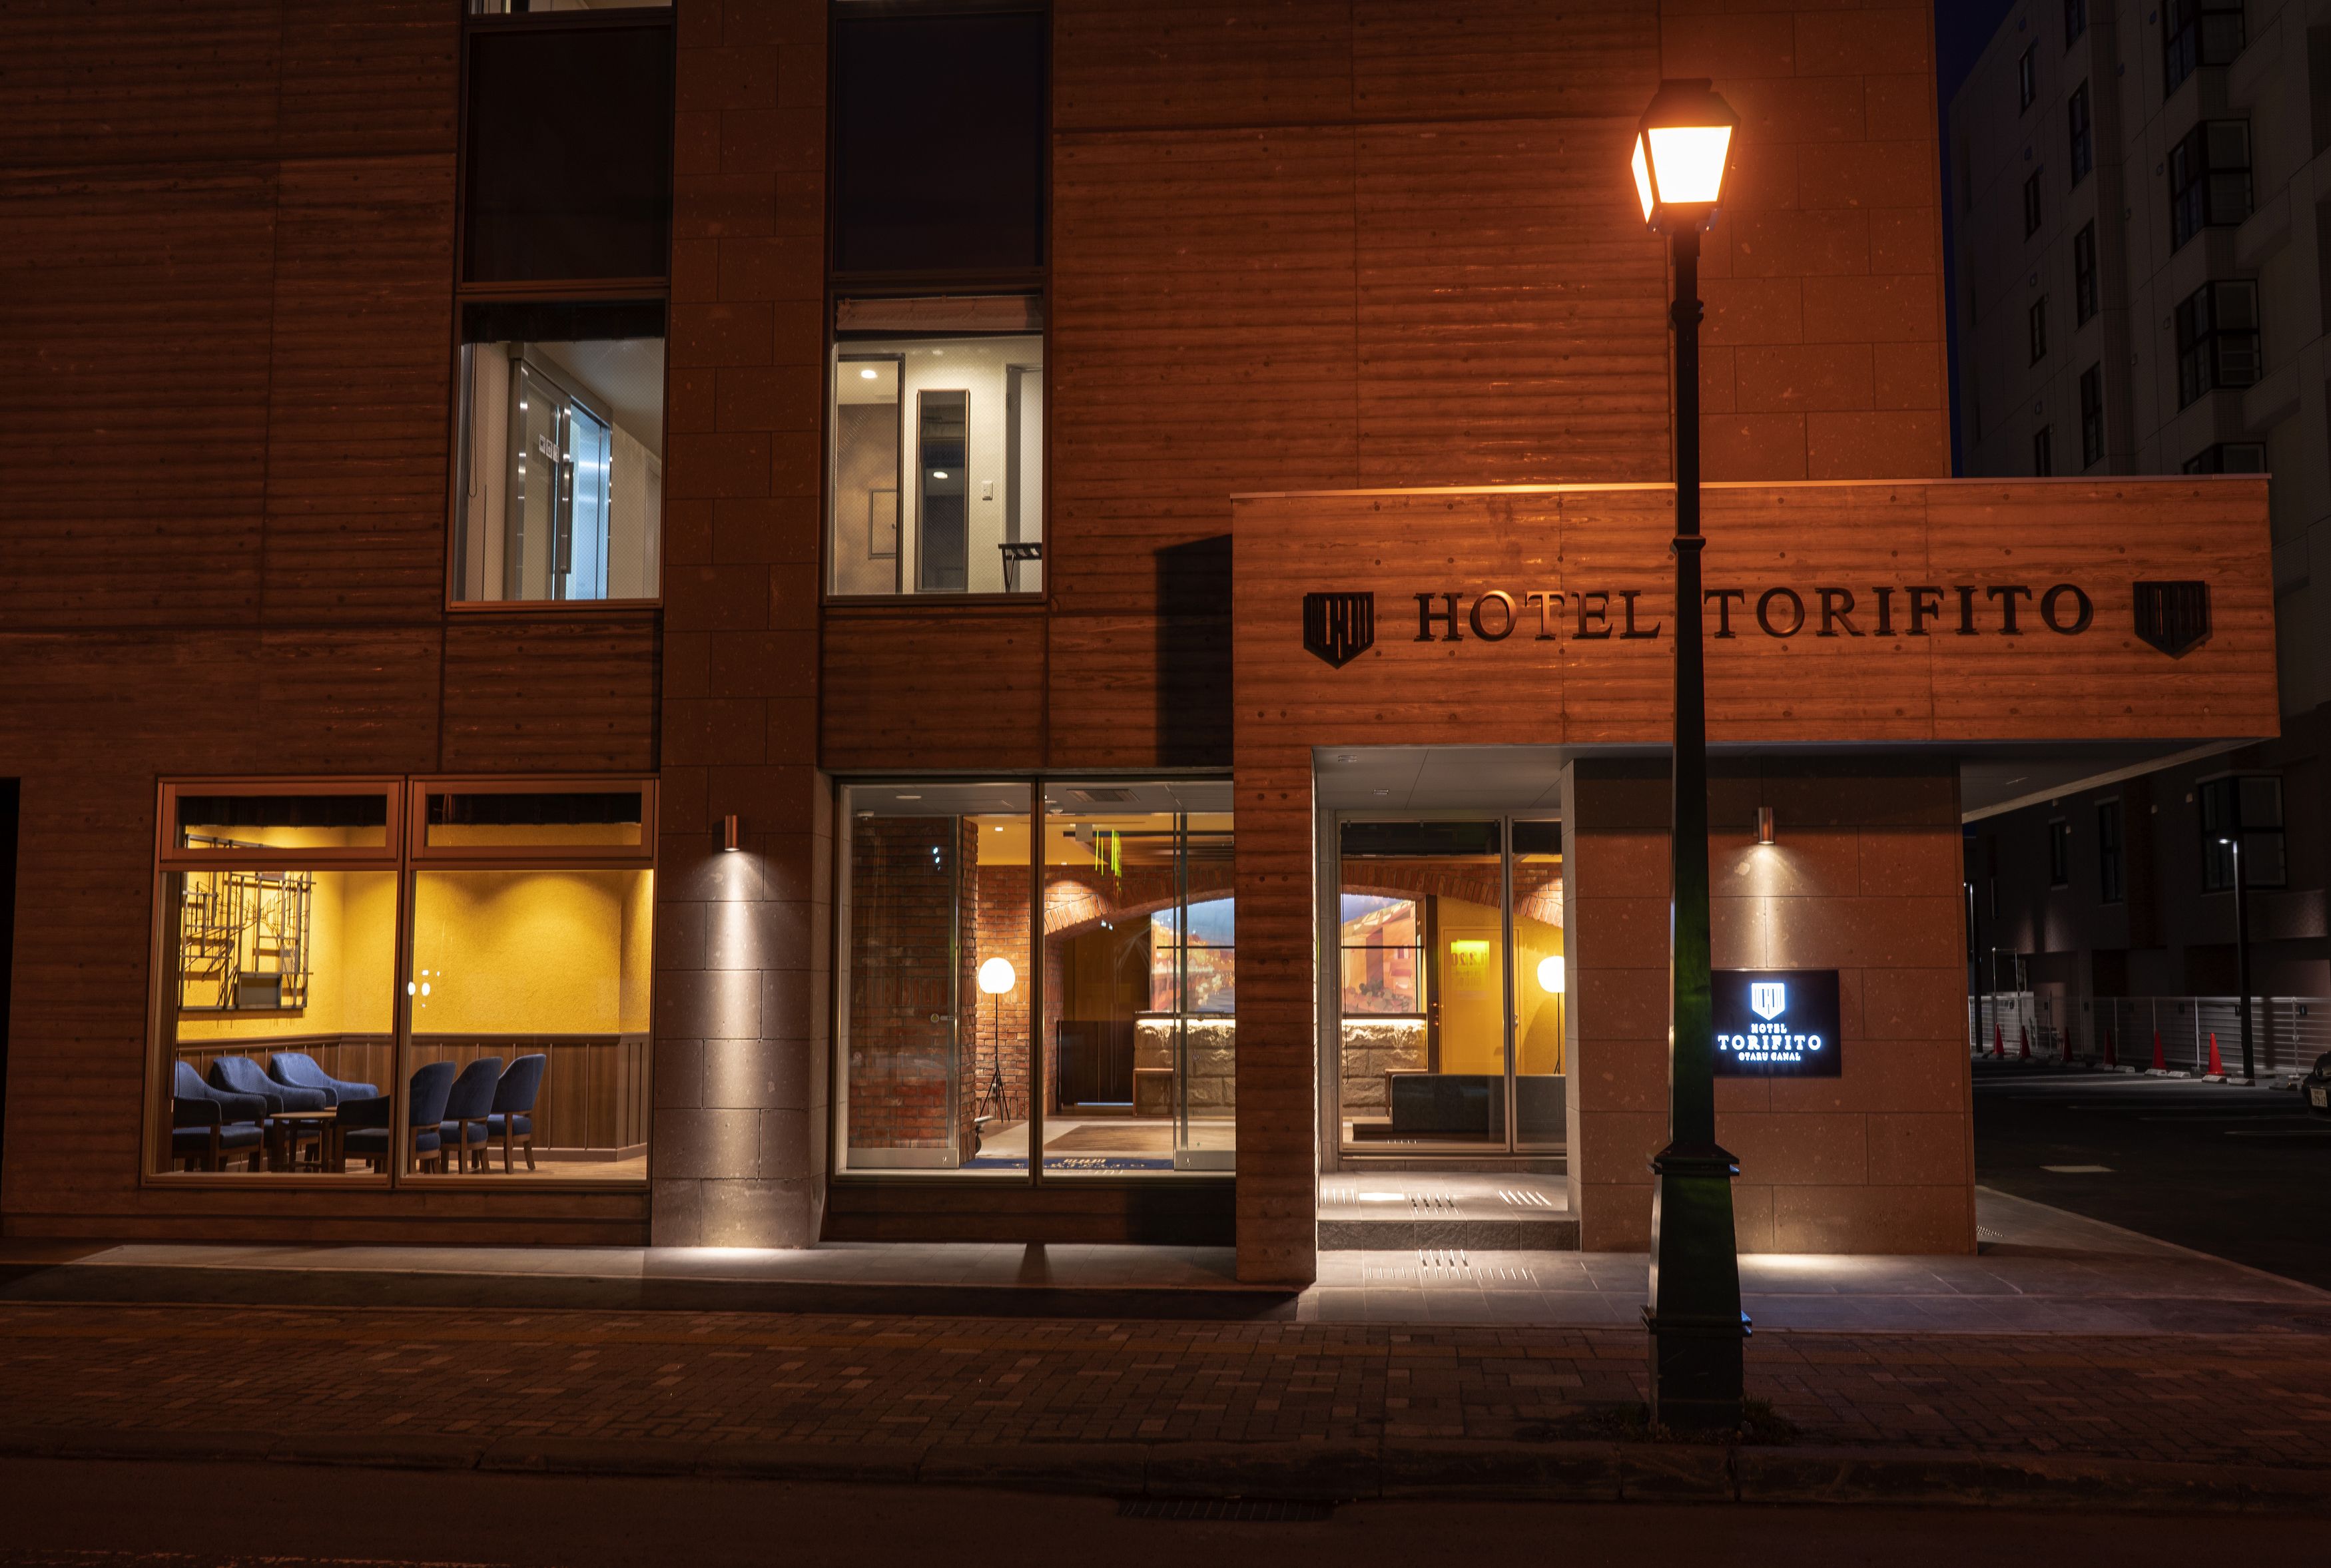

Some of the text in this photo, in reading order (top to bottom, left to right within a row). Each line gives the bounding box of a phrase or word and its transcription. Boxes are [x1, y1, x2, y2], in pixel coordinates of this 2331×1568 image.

[1413, 583, 2094, 641] HOTEL TORIFITO
[1751, 1023, 1788, 1033] HOTEL
[1717, 1035, 1822, 1051] TORIFITO
[1738, 1052, 1802, 1061] OTARU CANAL
